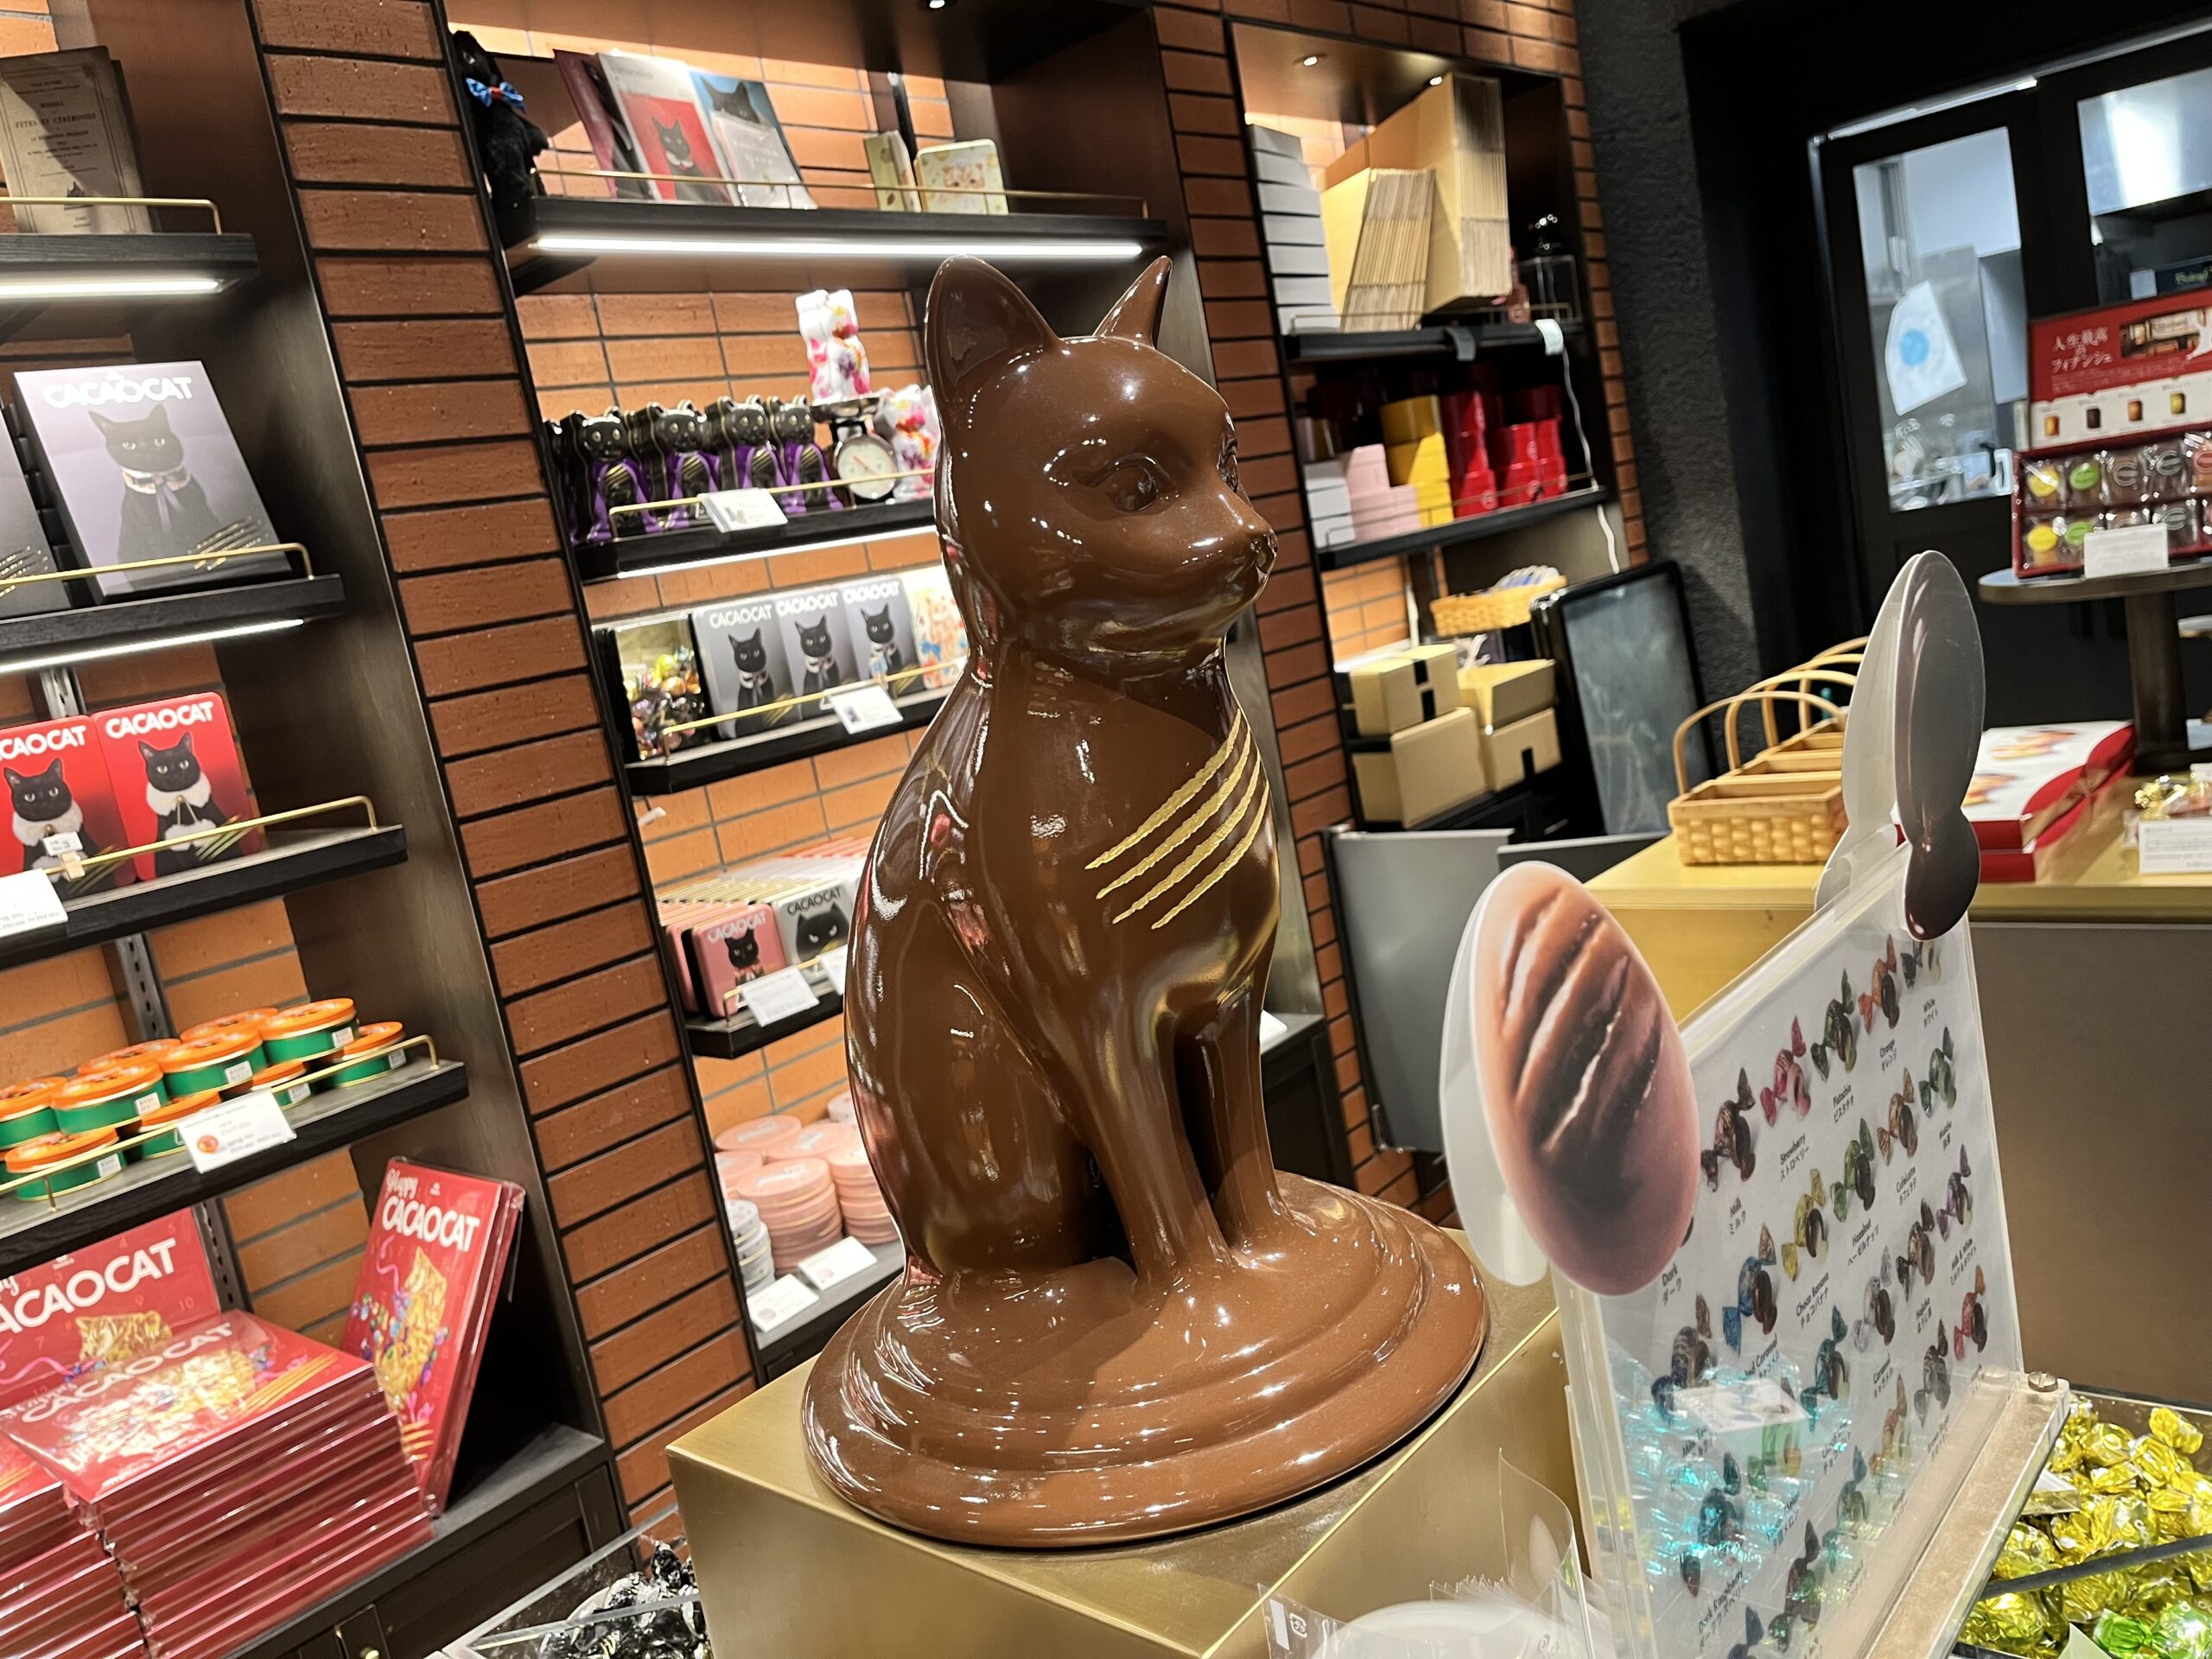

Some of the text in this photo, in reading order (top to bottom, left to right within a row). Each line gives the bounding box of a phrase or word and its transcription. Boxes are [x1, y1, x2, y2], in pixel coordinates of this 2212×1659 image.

[43, 377, 193, 409] CACAOCAT
[776, 592, 838, 616] CACAOCAT
[842, 582, 899, 604] CACAOCAT
[709, 605, 772, 629] CACAOCAT
[105, 701, 213, 739] CACAOCAT
[0, 725, 86, 760] CAOCAT
[788, 887, 842, 914] CACAOCAT
[708, 912, 766, 944] CACAOCAT
[1780, 1133, 1806, 1165] Strawberry
[1781, 1147, 1809, 1181] ストロベリー
[1730, 1196, 1742, 1217] Milk
[382, 1195, 480, 1252] CACAOCAT
[1729, 1211, 1746, 1236] ミルク
[1852, 1217, 1872, 1247] Hazelnut
[0, 1237, 176, 1333] ACAOCAT
[1662, 1262, 1678, 1287] Dark
[1662, 1277, 1681, 1306] ダーク
[1796, 1272, 1829, 1316] Choco Banana
[1801, 1287, 1828, 1329] チョコバナナ
[1757, 1332, 1777, 1367] Caramel
[22, 1322, 232, 1423] CACAOCAT
[1873, 1352, 1891, 1384] Caramel
